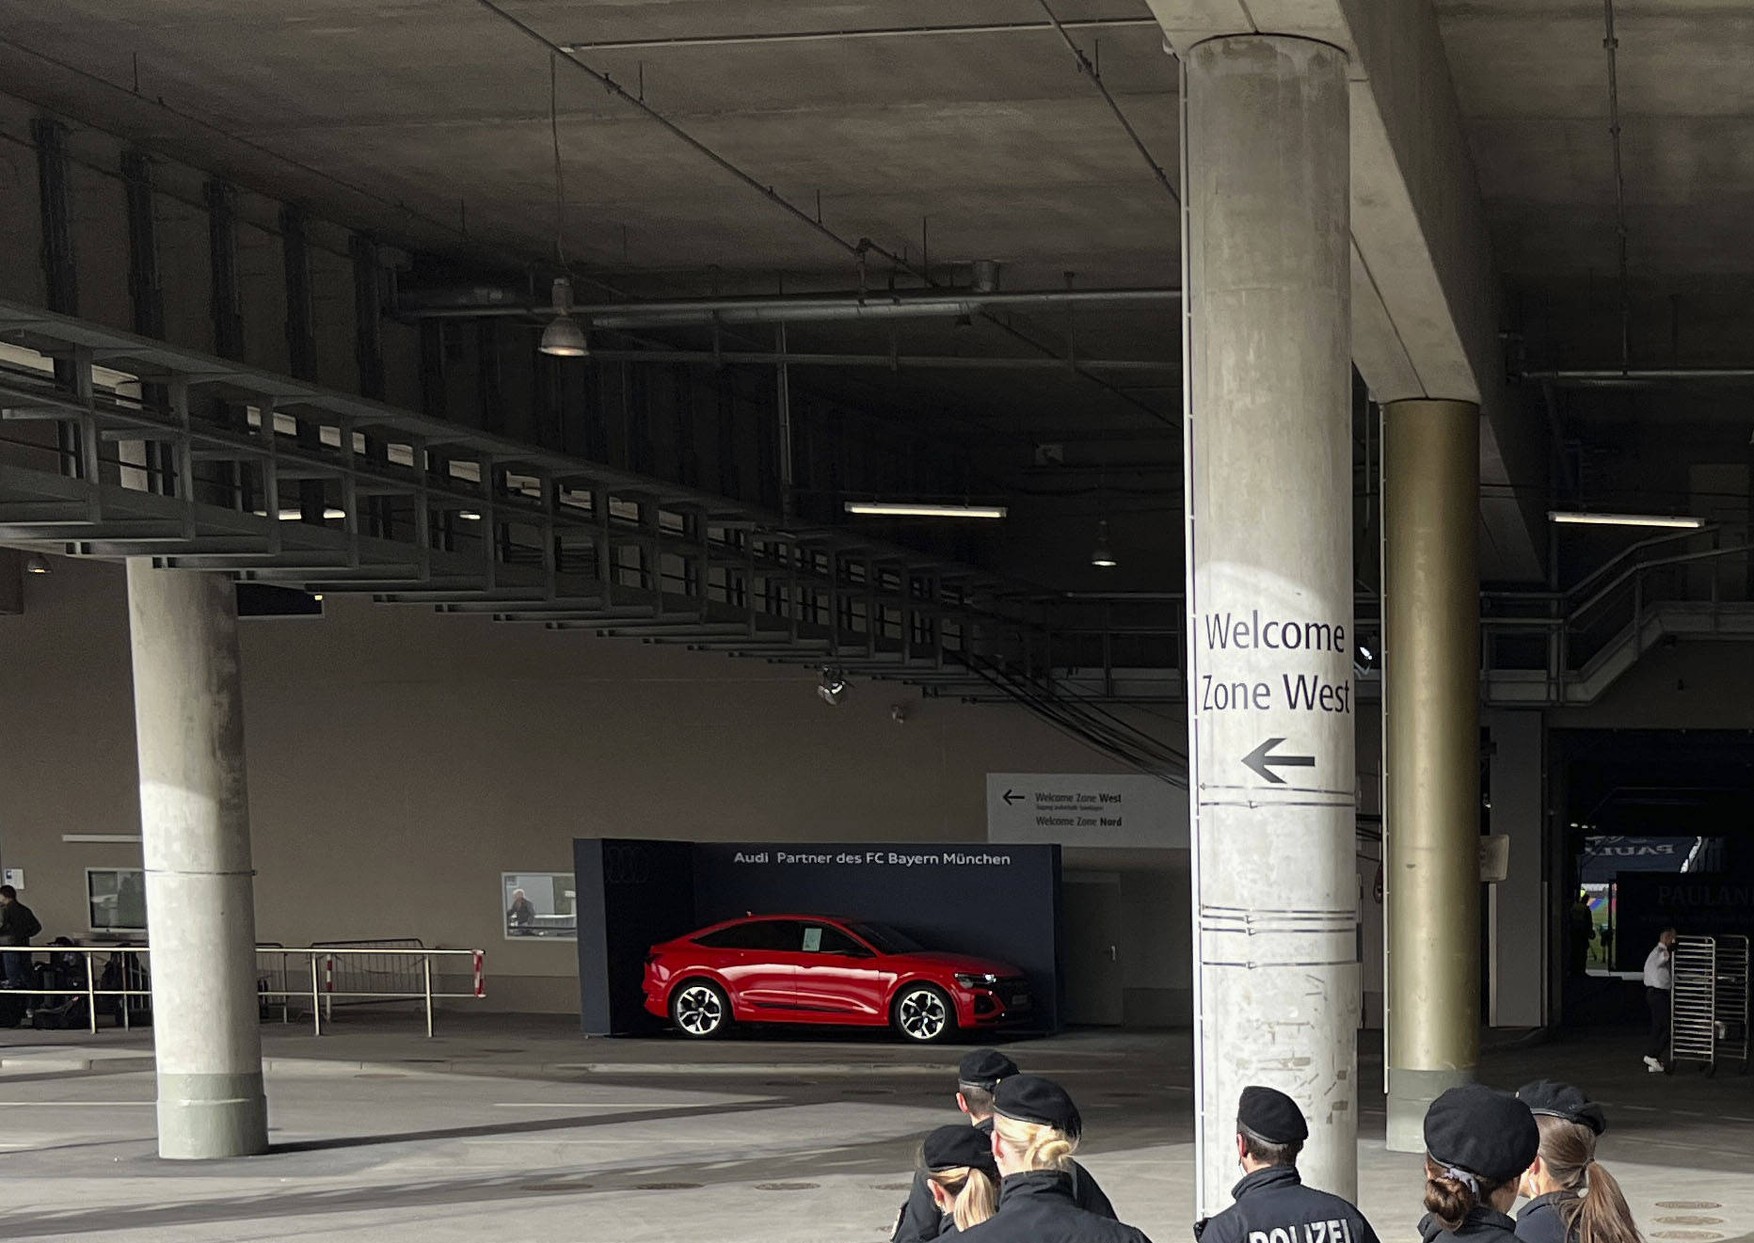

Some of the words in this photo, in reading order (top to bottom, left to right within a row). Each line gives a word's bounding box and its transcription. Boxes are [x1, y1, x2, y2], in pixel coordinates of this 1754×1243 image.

[1205, 609, 1346, 654] Welcome
[1202, 674, 1271, 711] Zone
[1283, 674, 1351, 715] West
[1035, 792, 1074, 802] Welcome
[1077, 793, 1096, 803] Zone
[1099, 793, 1122, 803] West
[1036, 816, 1074, 826] Welcome
[1077, 817, 1097, 826] Zone
[1100, 817, 1122, 826] Nord
[734, 852, 769, 863] Audi
[777, 852, 832, 864] Partner
[836, 852, 862, 864] des
[866, 852, 884, 864] FC
[889, 853, 939, 867] Bayern
[943, 852, 1011, 865] München
